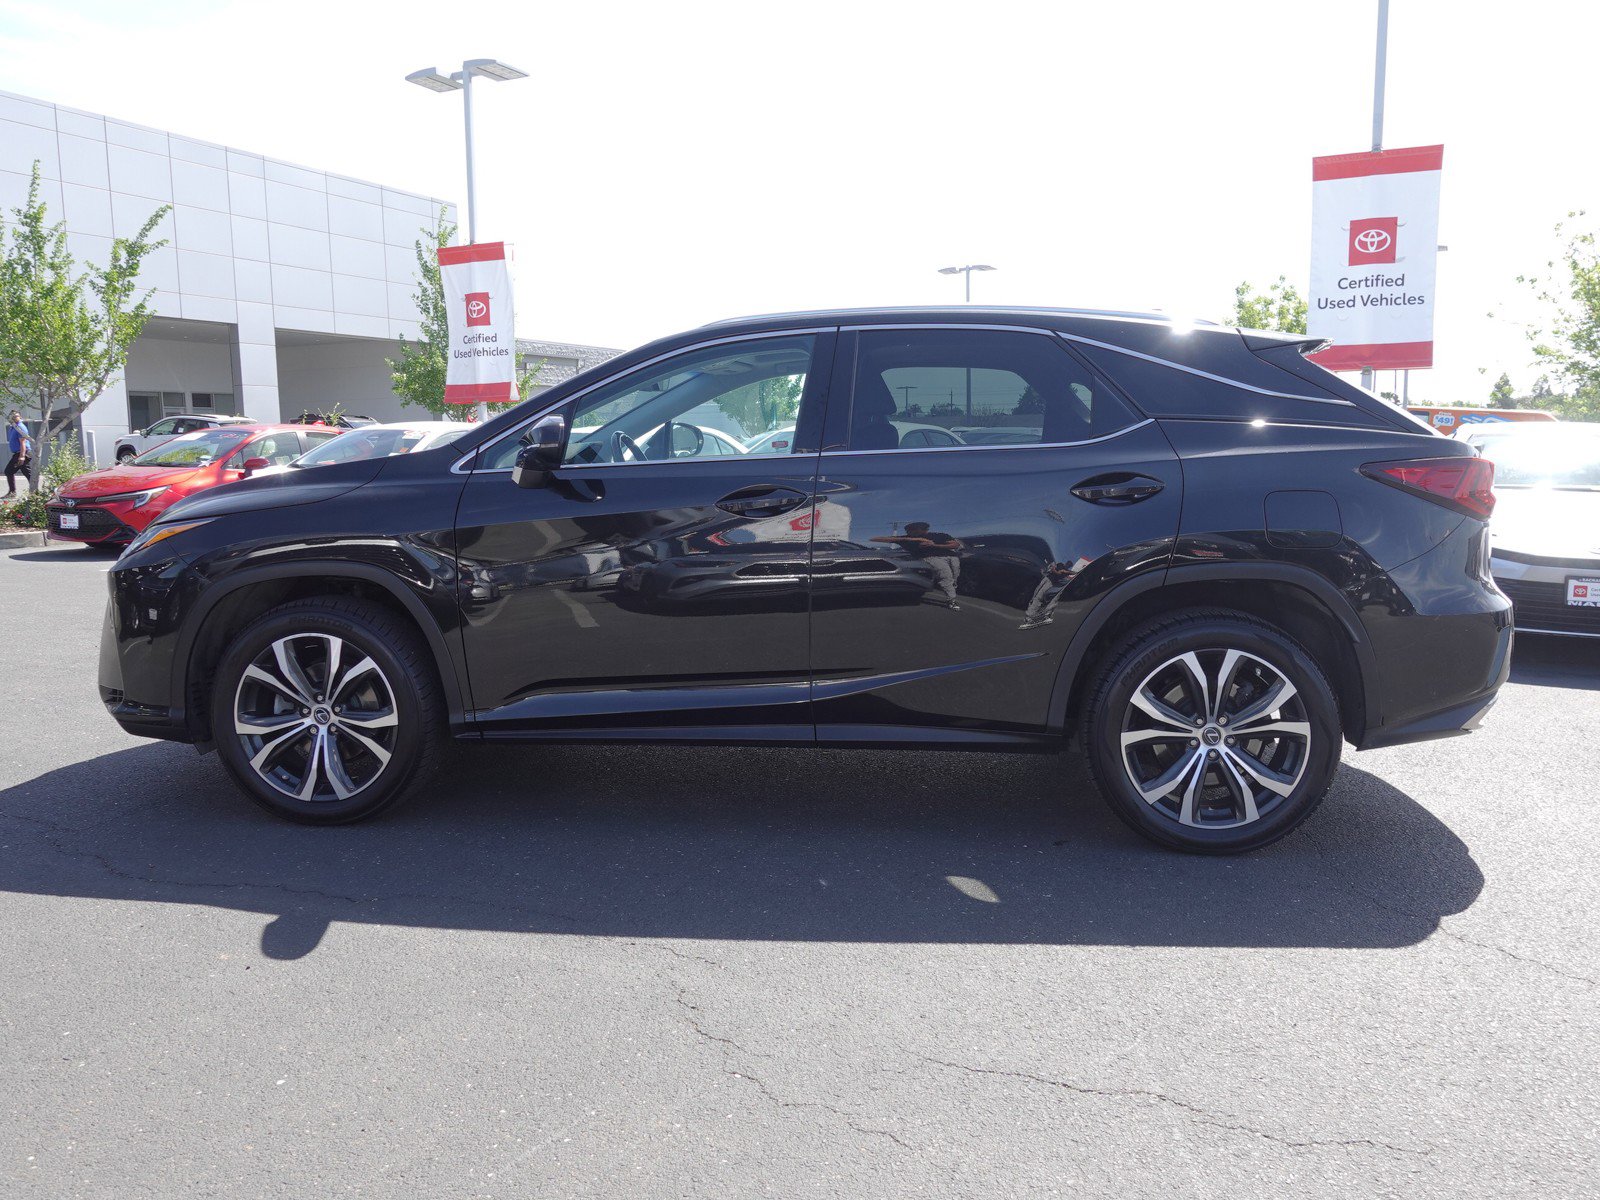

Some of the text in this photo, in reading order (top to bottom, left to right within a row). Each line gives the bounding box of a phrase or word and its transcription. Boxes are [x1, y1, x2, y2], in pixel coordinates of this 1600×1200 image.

[1337, 273, 1405, 290] Certified
[1317, 292, 1425, 310] Used Vehicles
[463, 333, 497, 345] Certified
[454, 346, 509, 359] Used Vehicles
